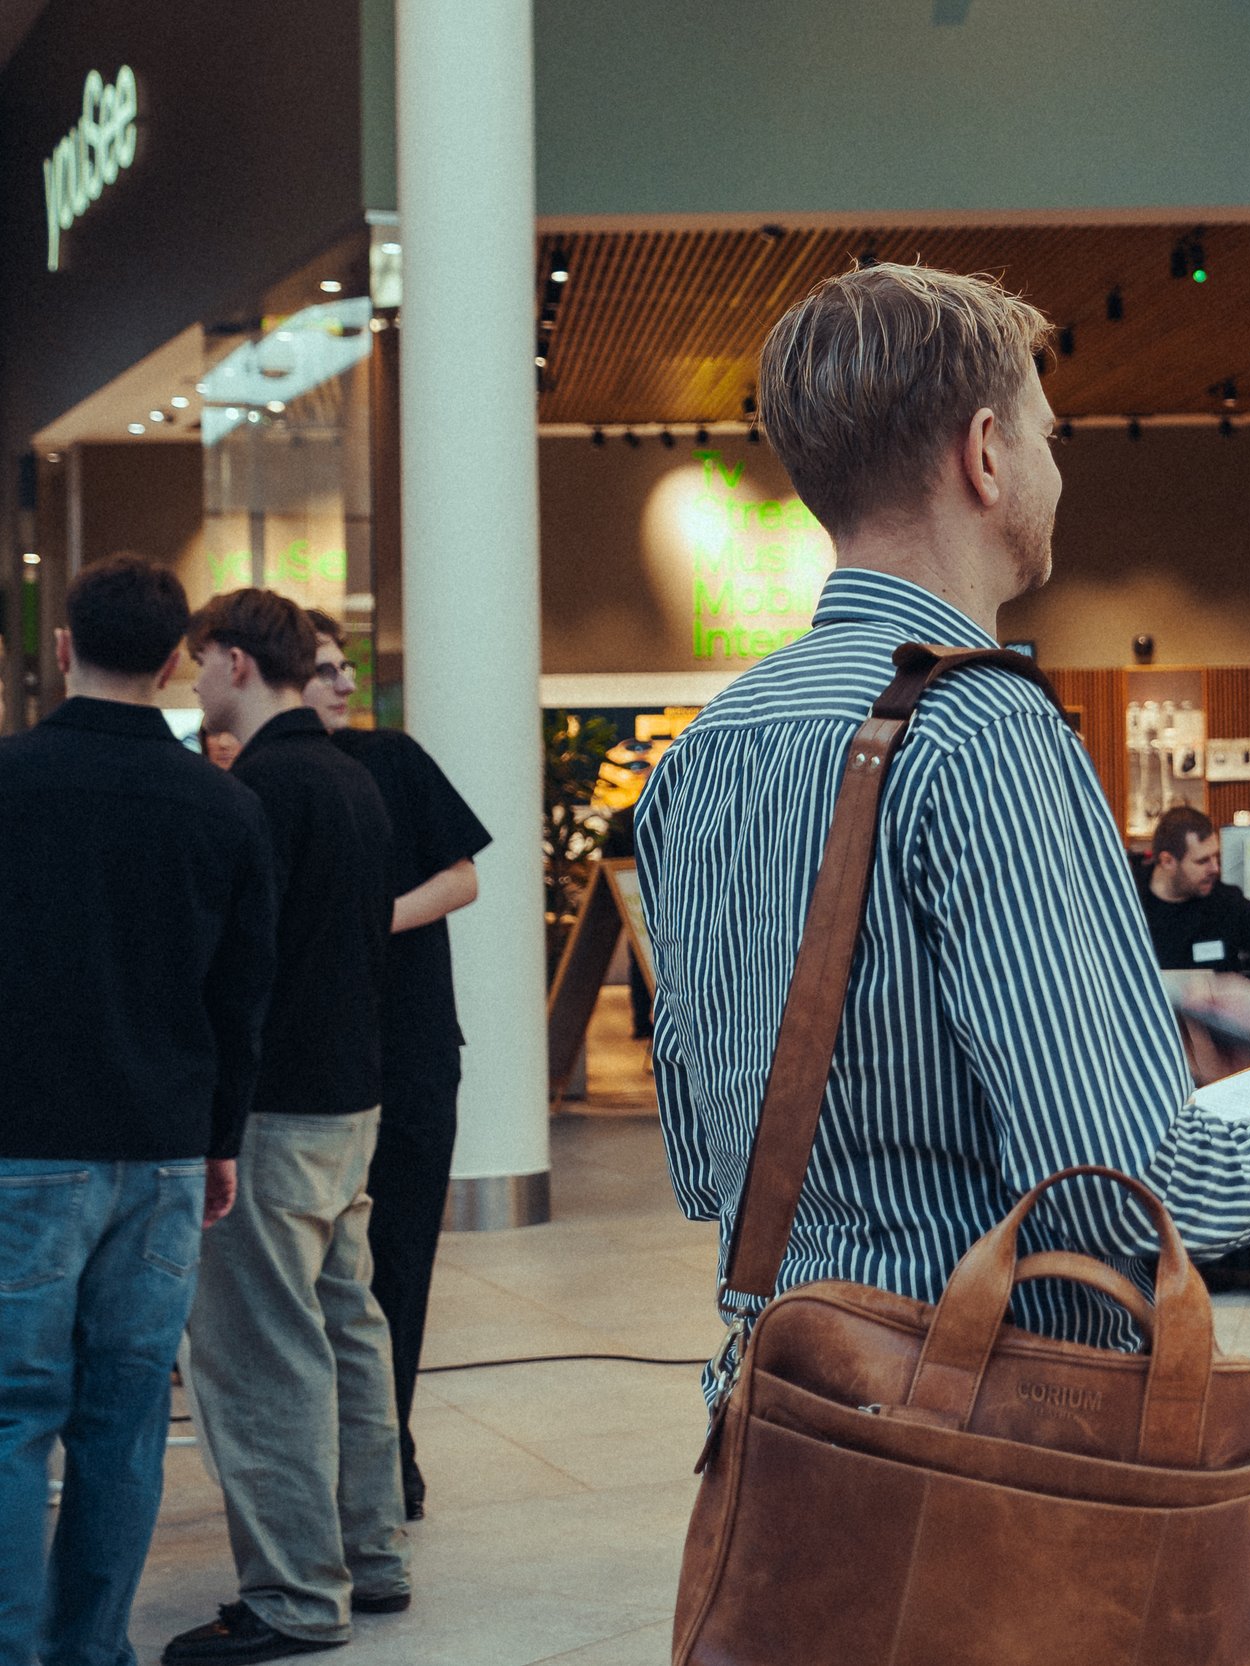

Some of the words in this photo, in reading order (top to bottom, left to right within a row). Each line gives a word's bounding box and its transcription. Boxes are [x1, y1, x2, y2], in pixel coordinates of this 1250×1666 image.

[692, 451, 746, 489] Tv
[693, 493, 820, 530] Strea
[693, 618, 811, 660] Inter
[1017, 1382, 1103, 1412] CORIUM
